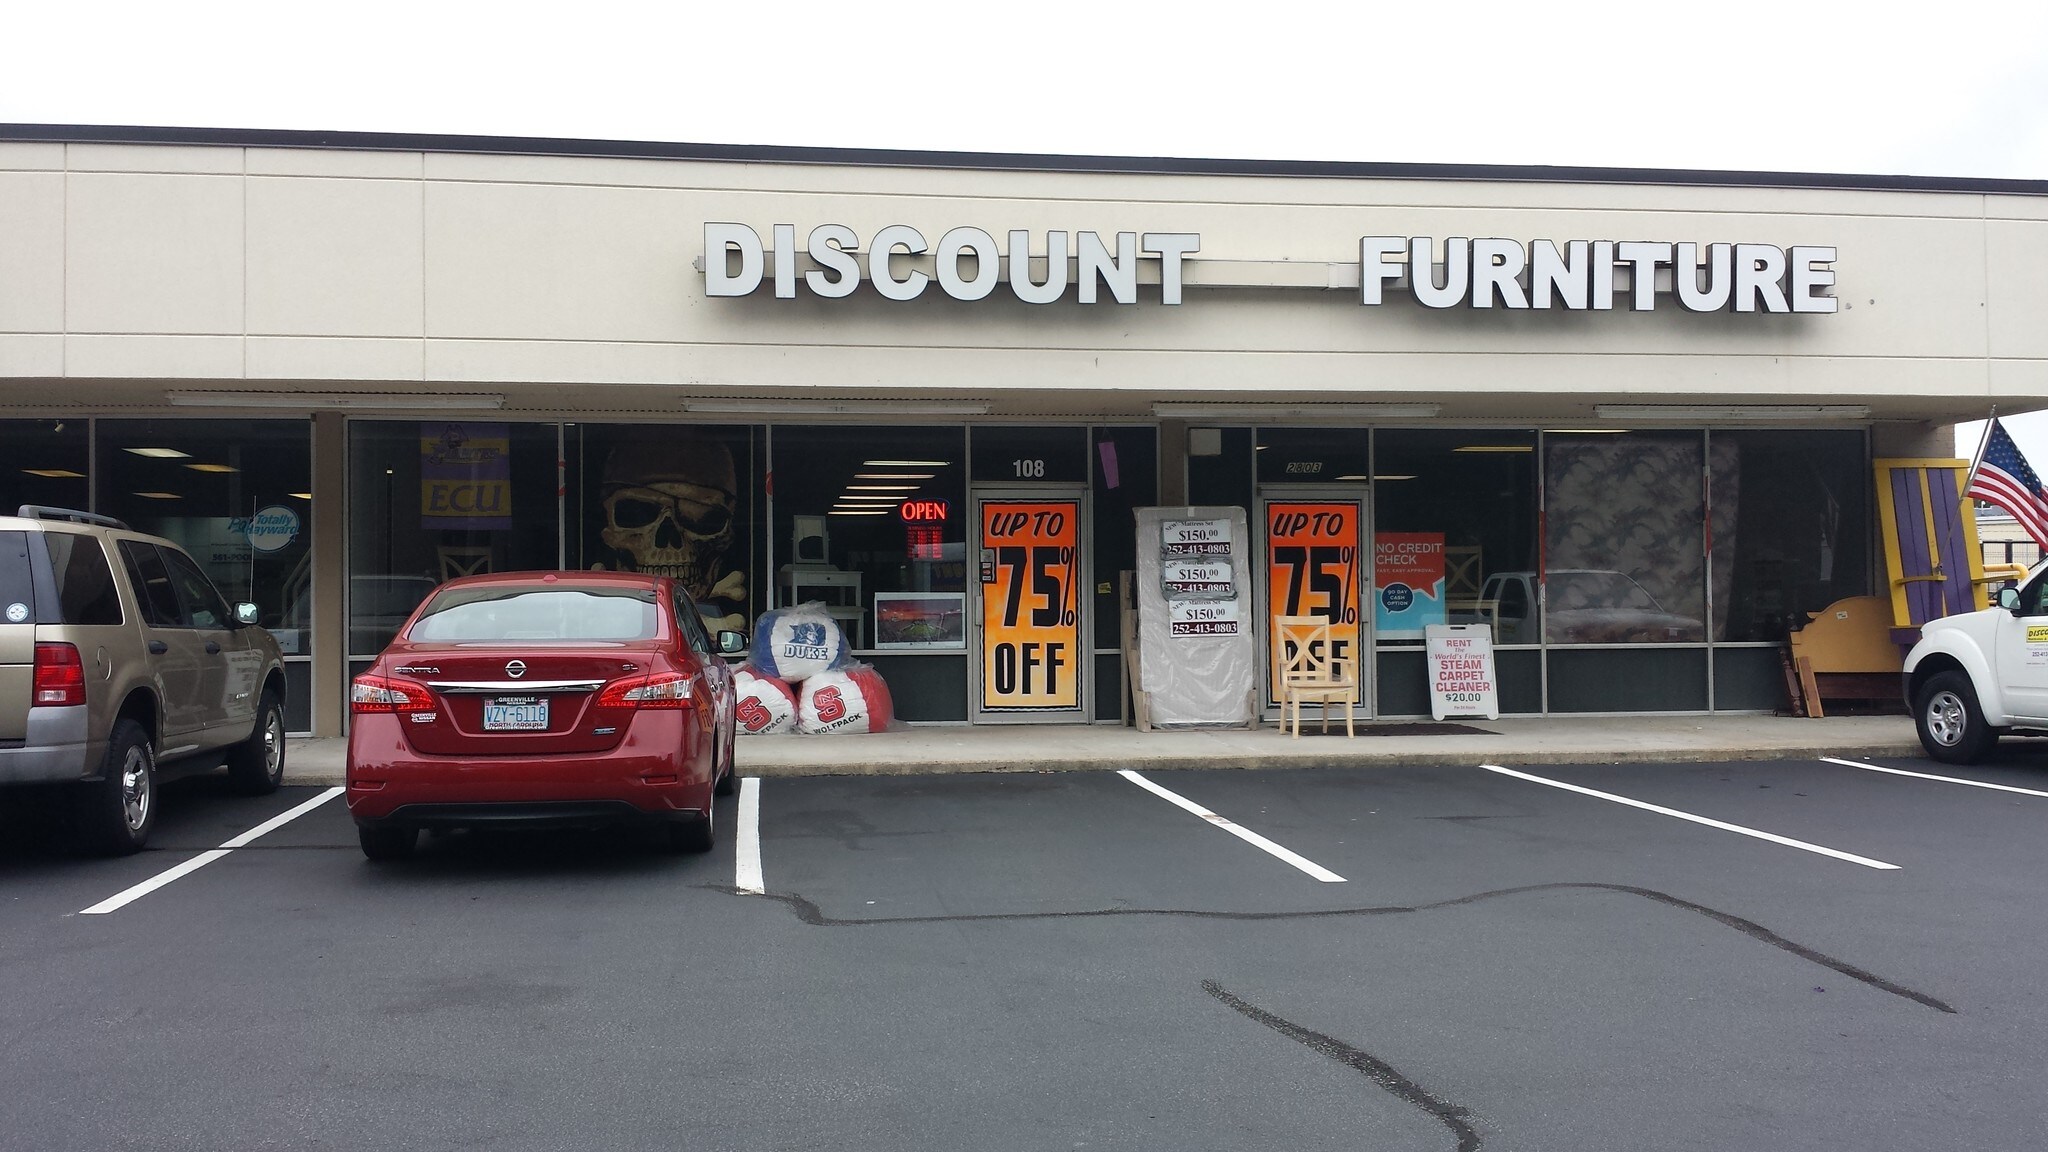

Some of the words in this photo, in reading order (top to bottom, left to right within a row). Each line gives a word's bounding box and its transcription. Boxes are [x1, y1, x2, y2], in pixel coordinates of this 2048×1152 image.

[704, 222, 1201, 306] DISCOUNT
[1361, 236, 1839, 314] FURNITURE
[1013, 459, 1045, 478] 108
[1286, 462, 1322, 473] 2803
[428, 484, 502, 513] ECU
[901, 502, 946, 520] OPEN
[257, 514, 294, 526] Totally
[990, 512, 1029, 538] UP
[1033, 511, 1065, 537] TO
[1272, 512, 1309, 538] UP
[1311, 512, 1344, 537] TO
[1178, 529, 1219, 542] $150.00
[1168, 544, 1230, 554] 252-413-0803
[1376, 543, 1395, 553] NO
[1397, 543, 1442, 553] CREDIT
[1375, 554, 1417, 565] CHECK
[1179, 568, 1219, 580] $150.00
[999, 545, 1075, 627] 75%
[1274, 545, 1356, 626] 75%
[1186, 608, 1226, 620] $150.00
[1173, 623, 1237, 634] 252-413-0803
[1446, 639, 1472, 647] RENT
[783, 644, 829, 661] DUKE
[394, 666, 441, 674] SENTRA
[994, 642, 1065, 695] OFF
[1440, 660, 1482, 670] STEAM
[1439, 671, 1485, 681] CARPET
[1436, 682, 1491, 692] CLEANER
[1445, 693, 1481, 702] $20.00
[486, 706, 546, 722] VZY-6118
[813, 713, 863, 734] WOLFPACK
